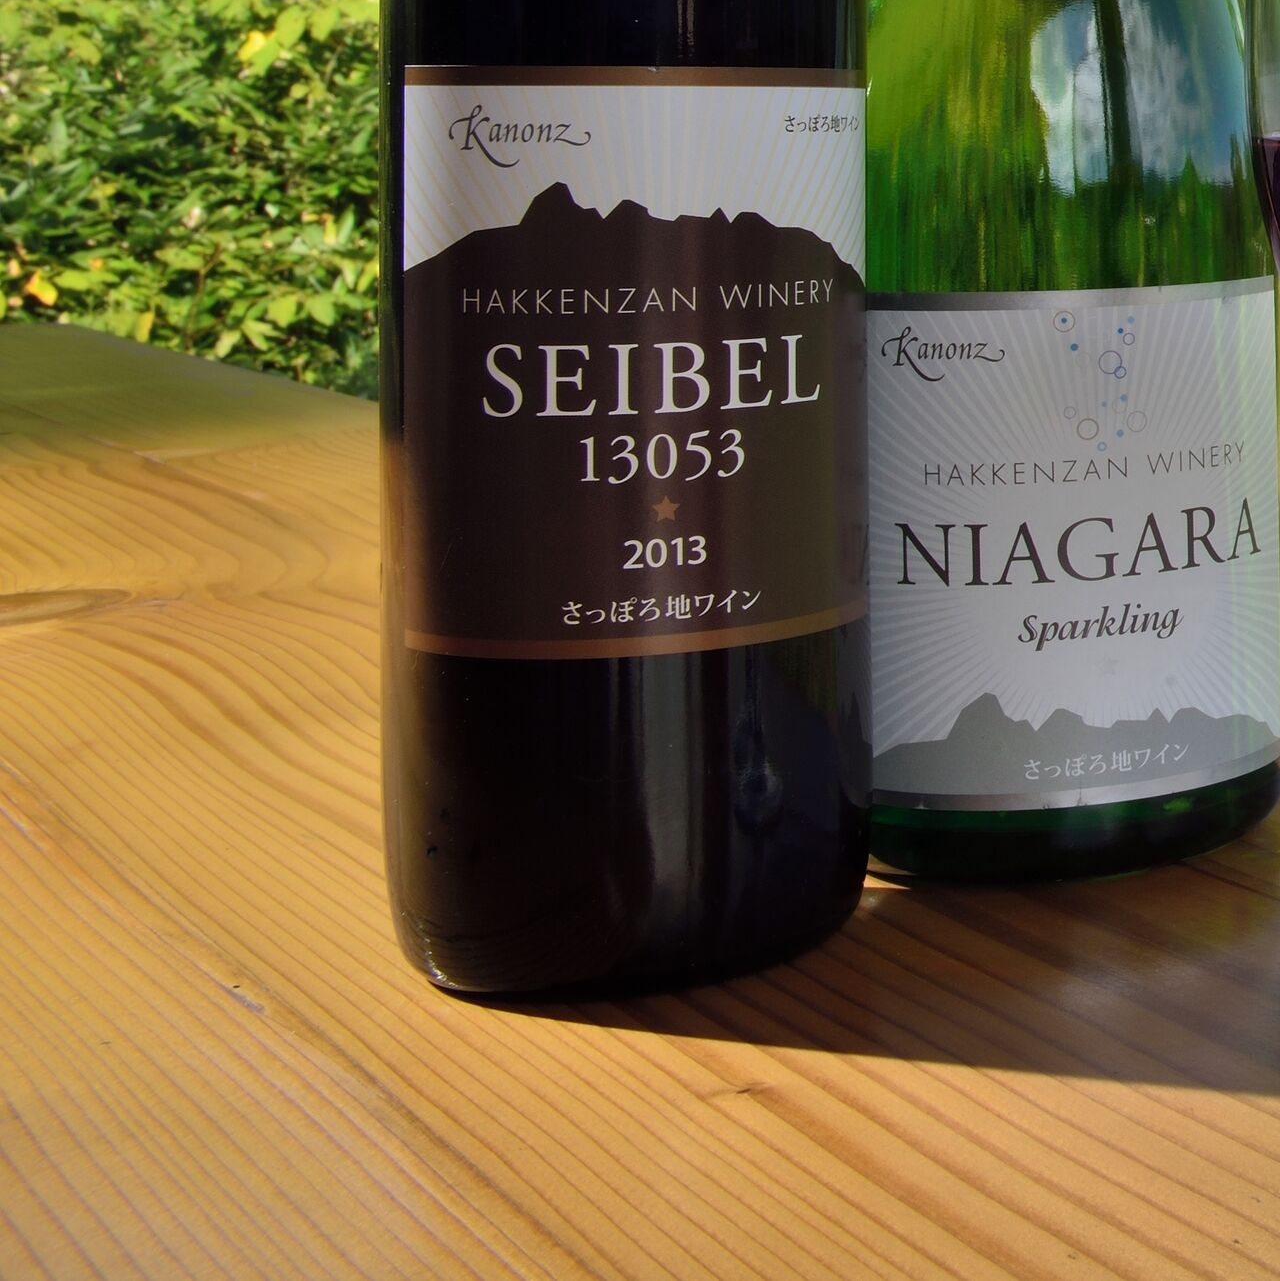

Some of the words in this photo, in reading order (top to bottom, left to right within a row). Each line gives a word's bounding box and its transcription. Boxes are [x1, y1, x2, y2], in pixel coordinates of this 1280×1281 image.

[448, 104, 592, 168] Kanonz
[784, 115, 860, 134] さっぽろ地ワイン
[463, 286, 697, 314] HAKKENZAN
[719, 278, 835, 310] WINERY
[482, 334, 821, 418] SEIBEL
[881, 326, 1005, 382] Kanonz
[579, 429, 746, 485] 13053
[924, 456, 1128, 486] HAKKENZAN
[1147, 440, 1245, 476] WINERY
[622, 536, 707, 570] 2013
[894, 497, 1262, 588] NIAGARA
[561, 589, 762, 626] さっぽろ地ワイン
[1017, 603, 1184, 652] Sparkling
[1023, 742, 1190, 781] さっぽろ地ワイン
